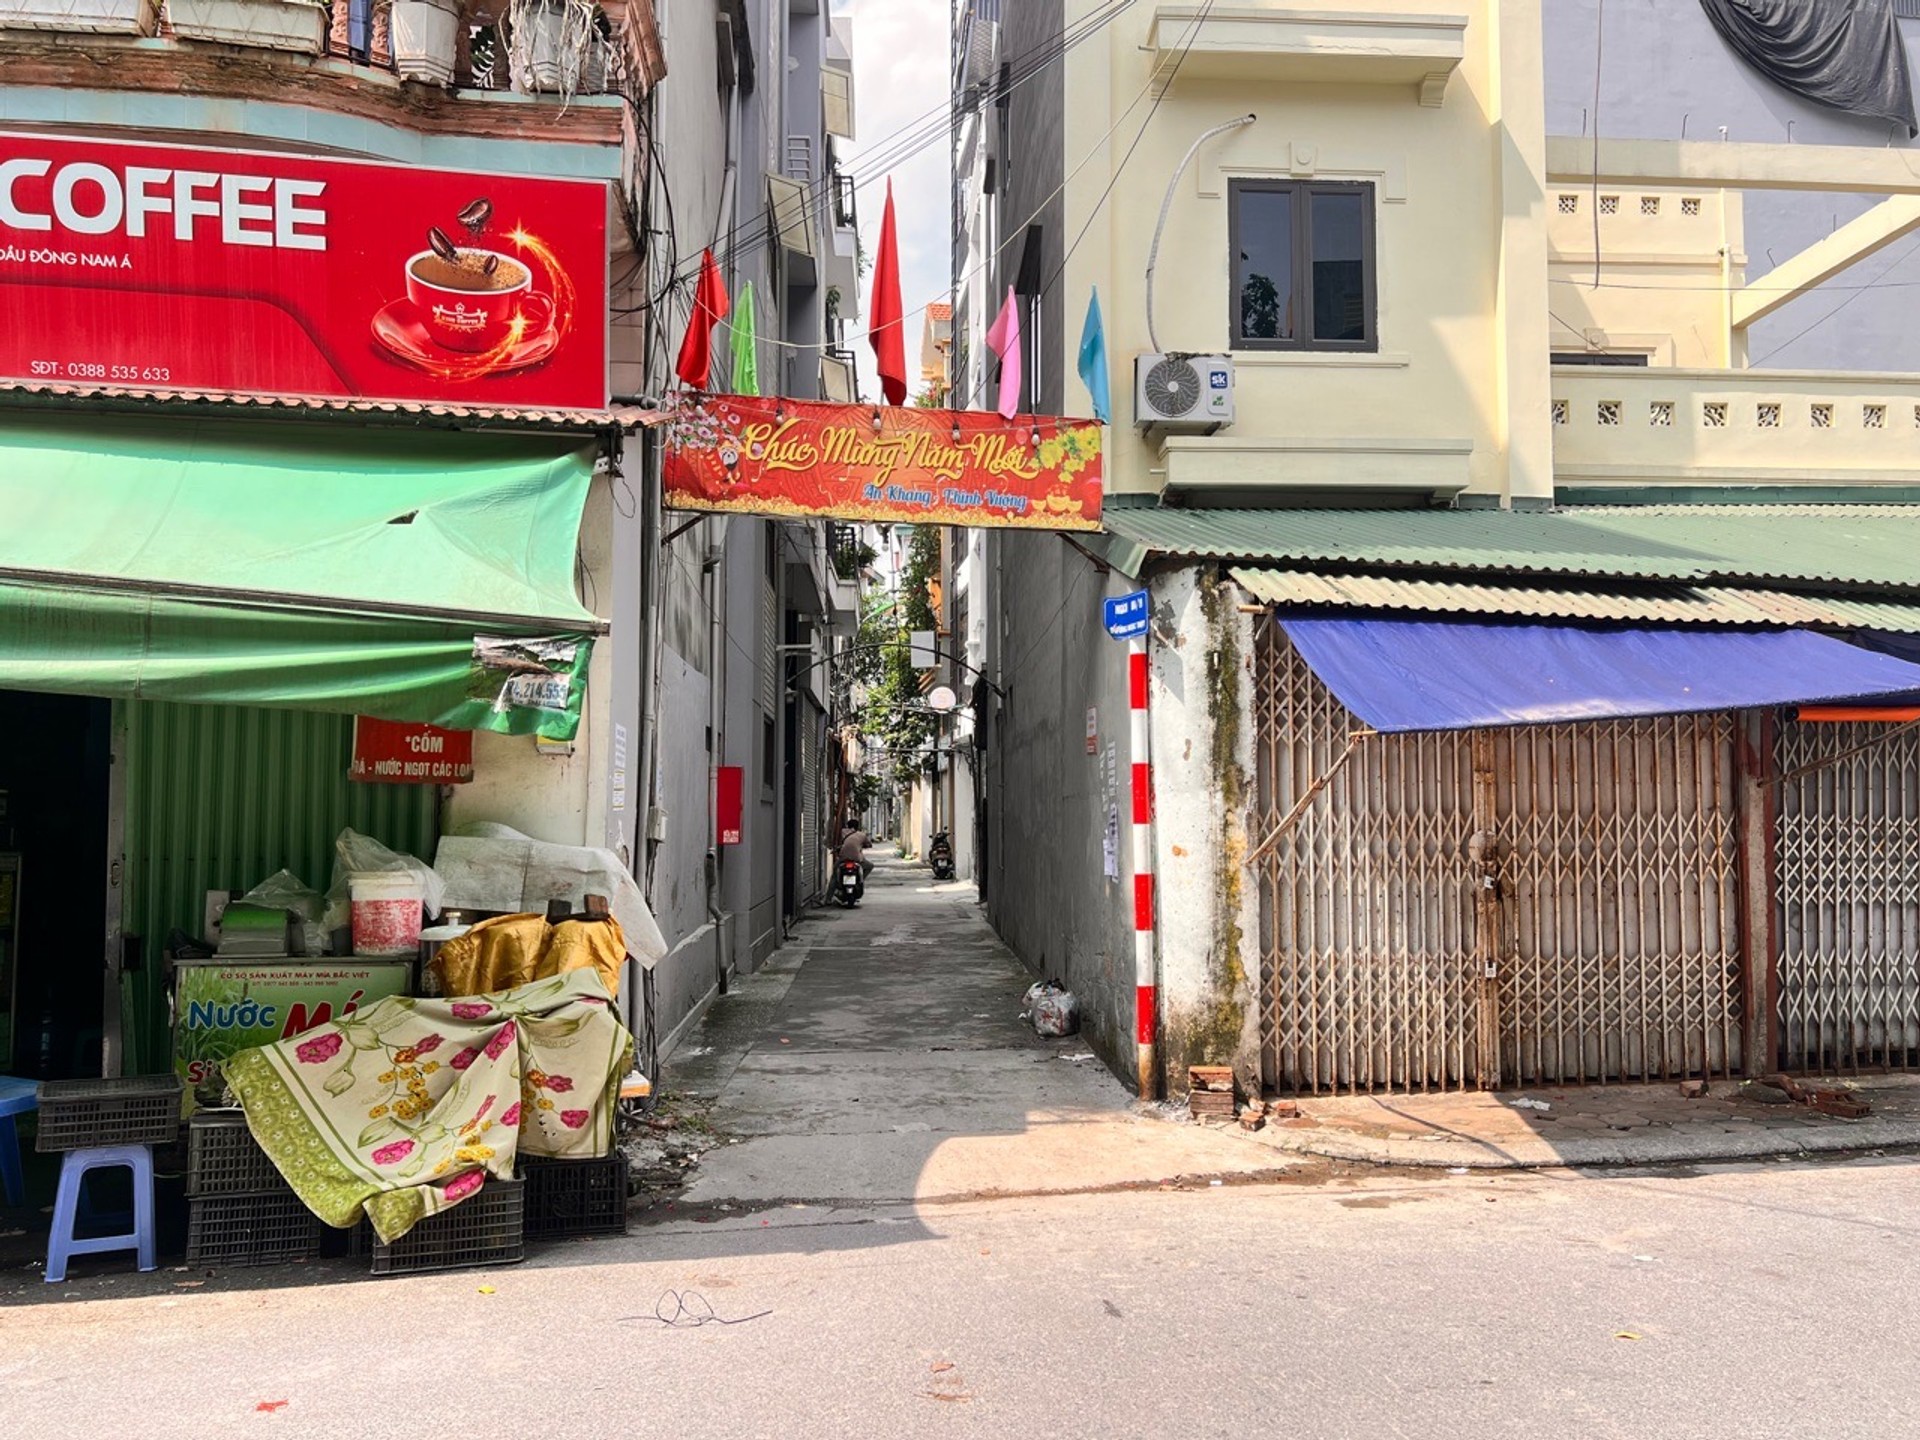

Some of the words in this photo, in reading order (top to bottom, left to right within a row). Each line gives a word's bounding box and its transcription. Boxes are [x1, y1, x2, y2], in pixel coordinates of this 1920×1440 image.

[0, 158, 327, 251] COFFEE
[29, 248, 77, 265] ĐÔNG
[81, 252, 117, 267] NAM
[120, 253, 132, 269] Á
[31, 360, 64, 375] SĐT:
[67, 362, 105, 378] 0388
[110, 365, 138, 379] 535
[142, 367, 170, 381] 633
[745, 417, 818, 471] Chúc
[820, 425, 900, 487] Mừng
[888, 430, 964, 479] Năm
[958, 432, 1040, 479] Mới
[863, 484, 883, 500] An
[886, 485, 931, 508] Khang
[943, 488, 981, 509] Thịnh
[984, 489, 1028, 512] Vượng
[375, 757, 402, 776] NƯỚC
[404, 761, 430, 779] NGỌT
[432, 759, 452, 777] CÁC
